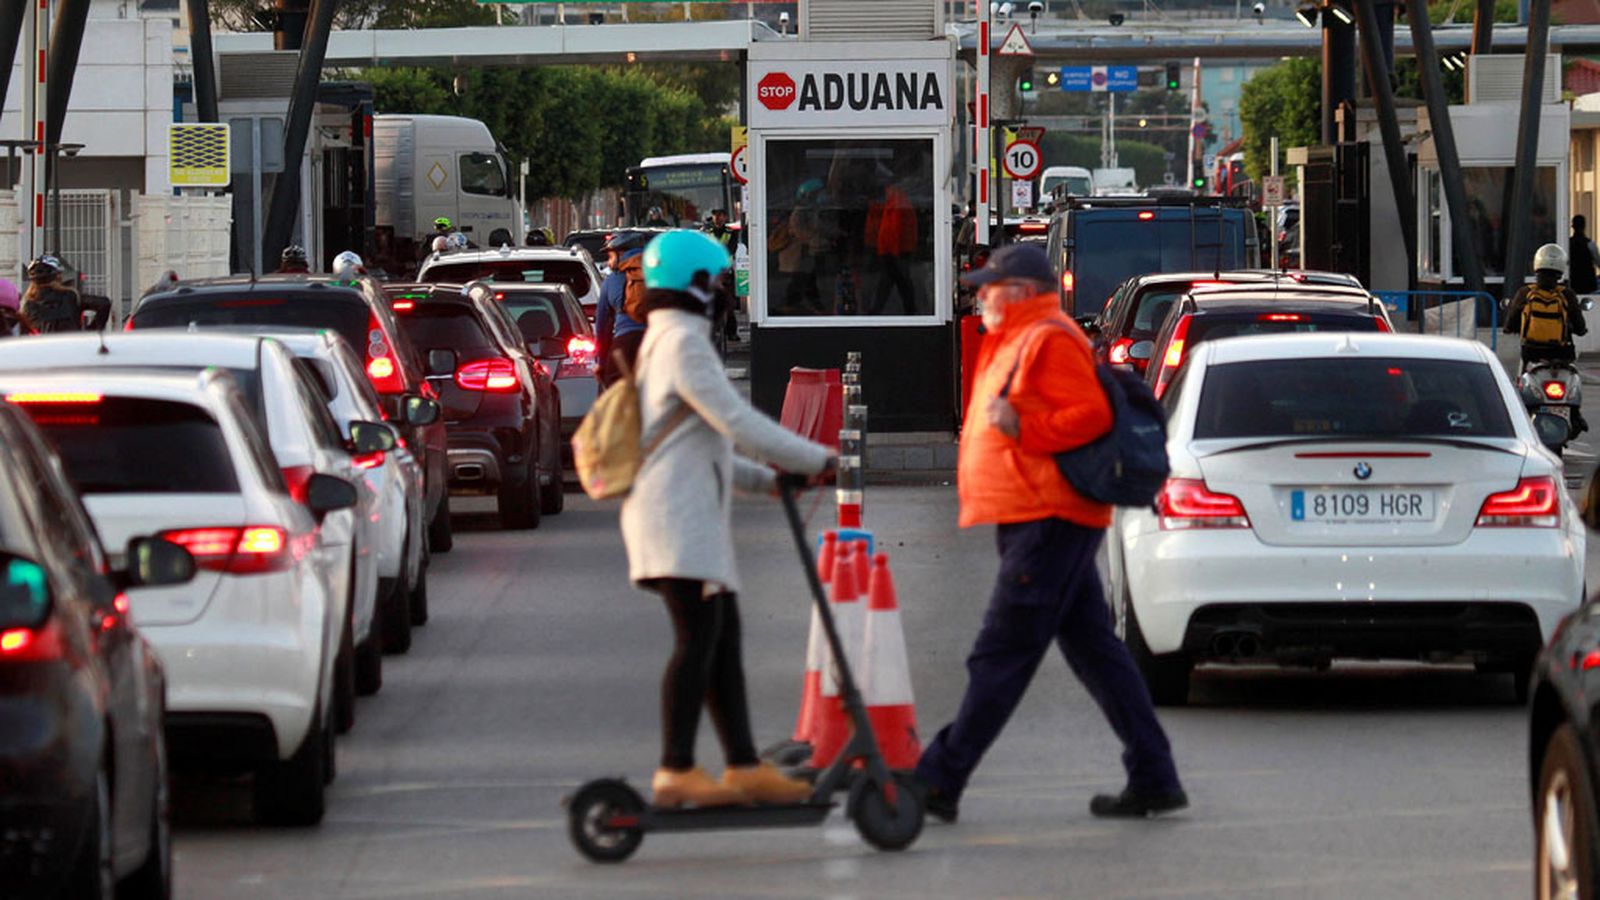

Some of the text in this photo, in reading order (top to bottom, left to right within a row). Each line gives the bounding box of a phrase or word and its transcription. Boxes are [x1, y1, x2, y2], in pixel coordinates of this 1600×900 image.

[760, 72, 944, 111] STOP ADUANA
[1010, 151, 1034, 169] 10
[1313, 494, 1423, 516] 8109 HGR
